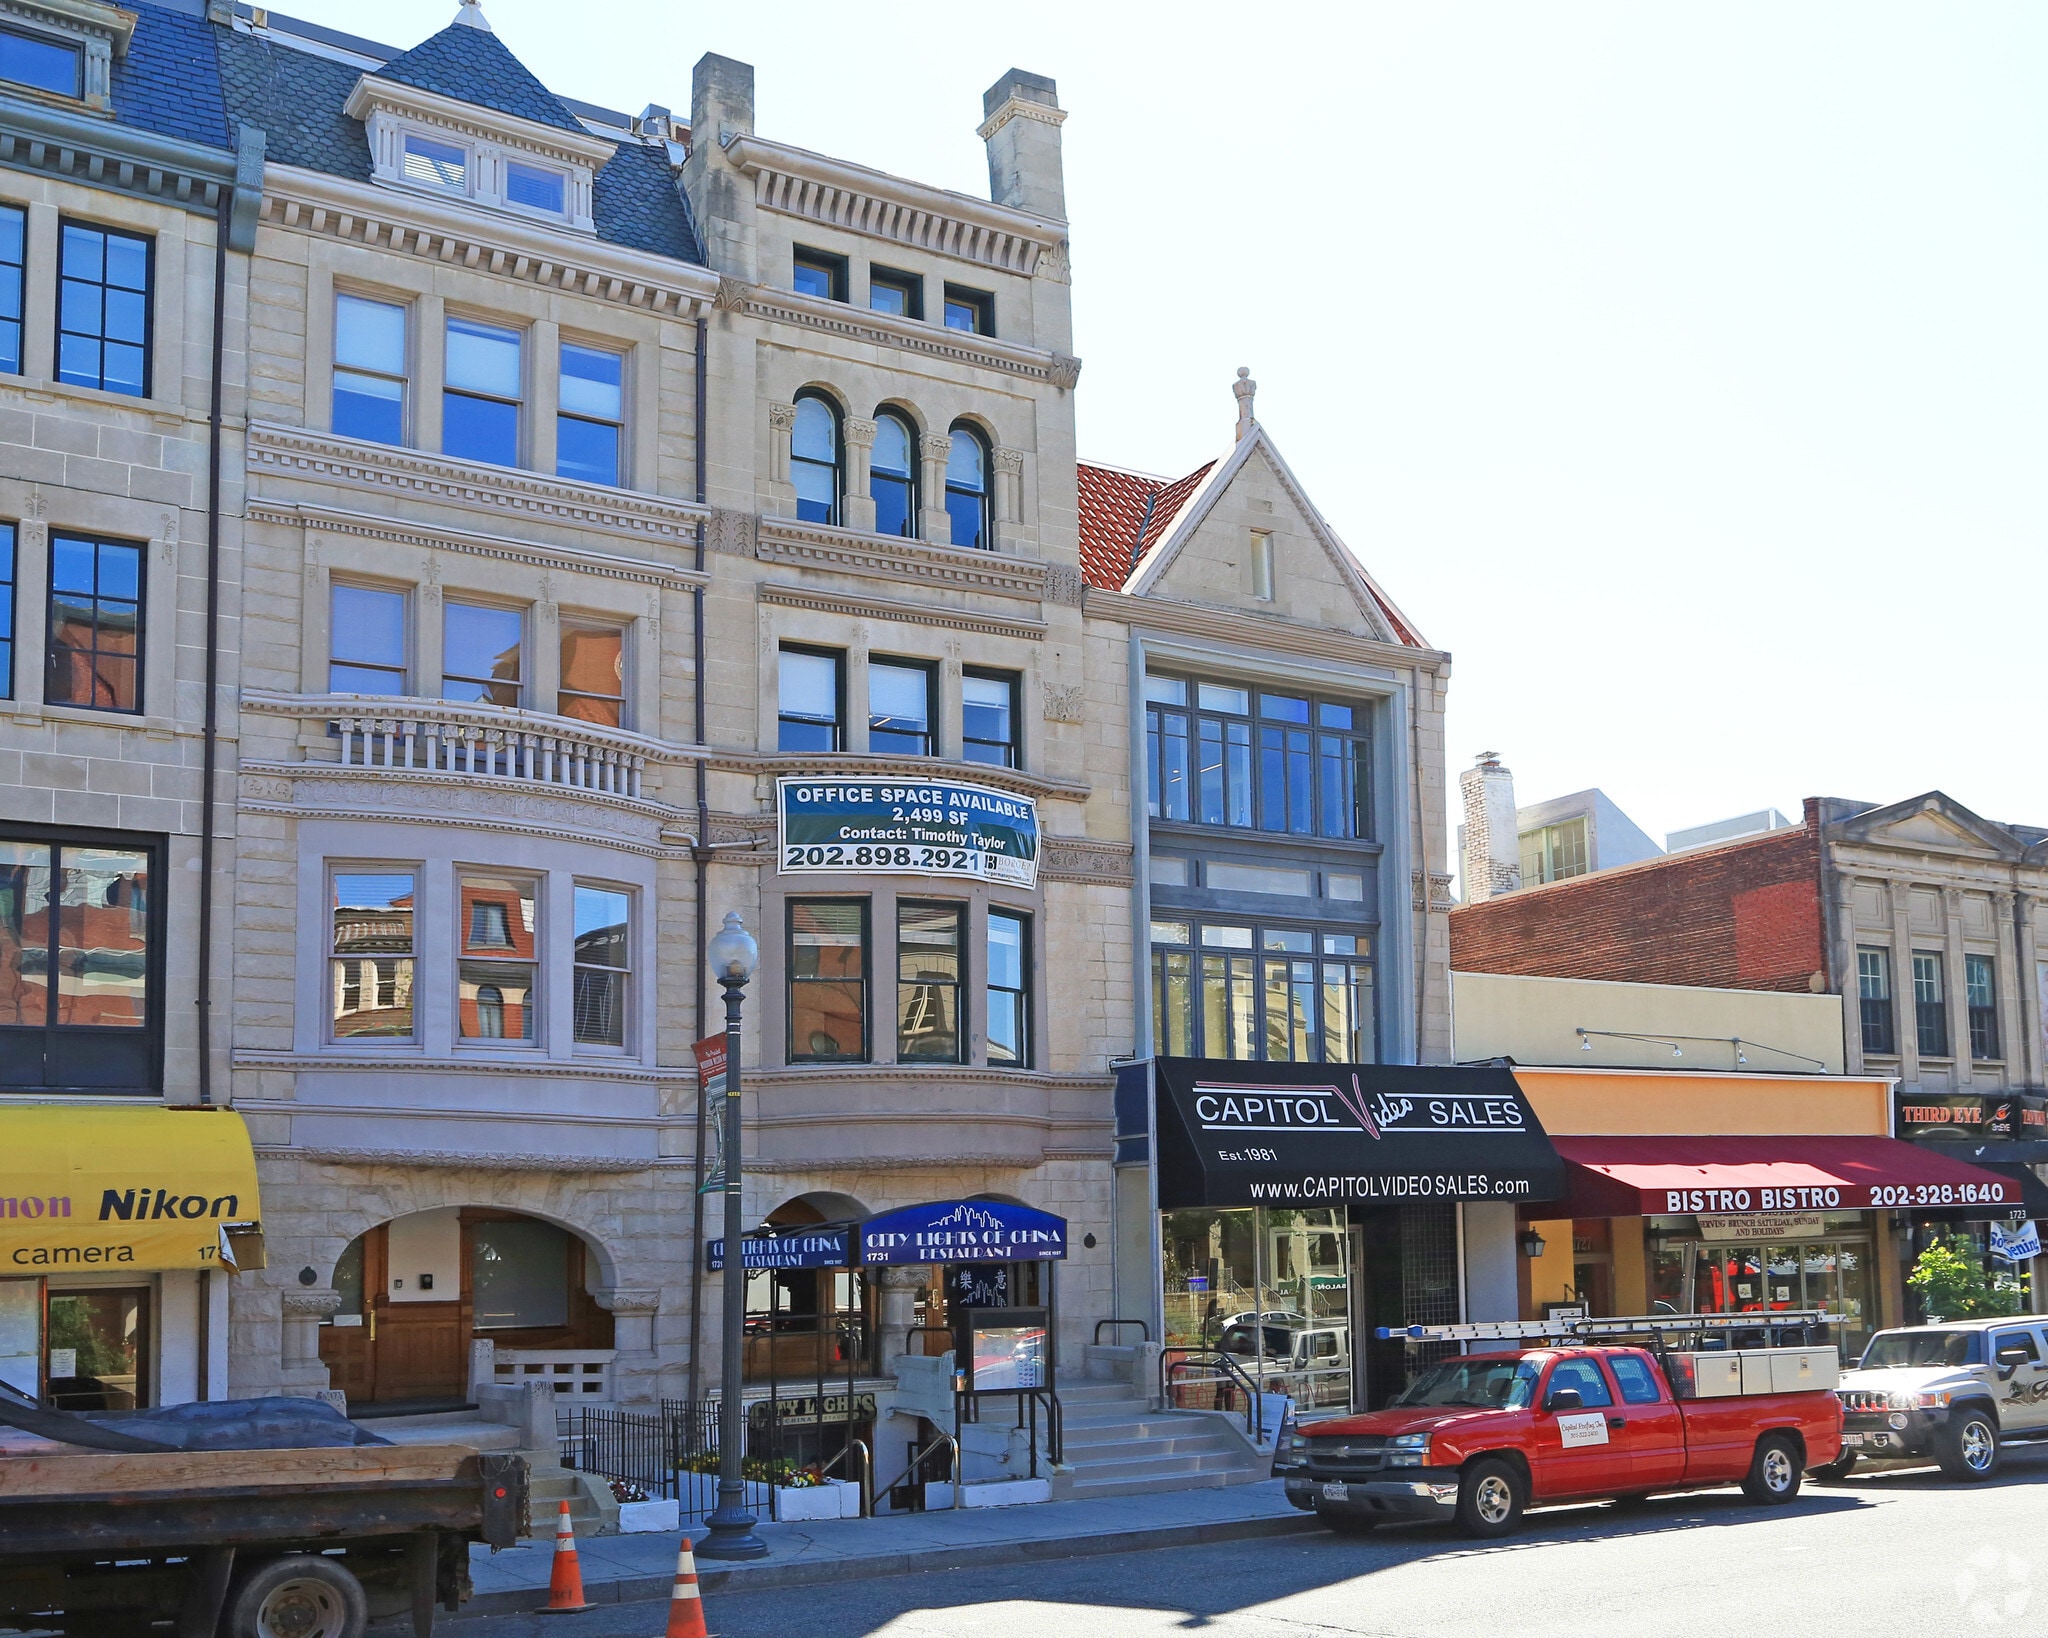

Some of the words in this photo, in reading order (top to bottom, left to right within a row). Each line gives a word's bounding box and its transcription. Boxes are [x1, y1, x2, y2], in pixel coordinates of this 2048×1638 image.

[796, 788, 873, 803] OFFICE
[880, 788, 943, 805] SPACE
[948, 791, 1029, 820] AVAILABLE
[892, 807, 943, 825] 2,499
[949, 812, 969, 826] SF
[839, 826, 907, 840] Contact:
[911, 828, 968, 847] Timothy
[971, 833, 1006, 850] Taylor
[787, 846, 979, 871] 202.898.2921
[1195, 1095, 1340, 1124] CAPITOL
[1334, 1073, 1414, 1140] Video
[1429, 1100, 1523, 1125] SALES
[1902, 1106, 1951, 1123] THIRD
[1952, 1107, 1982, 1124] EYE
[98, 1188, 239, 1221] Nikon
[1666, 1190, 1751, 1212] BISTRO
[1761, 1187, 1840, 1209] BISTRO
[1869, 1183, 2004, 1206] 202-328-1640
[1699, 1219, 1726, 1228] SERVING
[1728, 1219, 1757, 1228] BRUNCH
[1794, 1216, 1820, 1226] SUNDAY
[2009, 1210, 2027, 1219] 1723
[866, 1232, 911, 1248] CITY
[916, 1231, 977, 1247] LIGHTS
[982, 1230, 1005, 1245] OF
[1010, 1229, 1062, 1244] CHINA
[1735, 1228, 1750, 1236] AND
[1752, 1227, 1785, 1236] HOLIDAYS
[12, 1245, 135, 1265] camera
[742, 1239, 780, 1255] LIGHTS
[783, 1237, 800, 1253] OF
[803, 1237, 841, 1253] CHINA
[919, 1246, 1014, 1260] RESTAURANT
[744, 1254, 804, 1268] RESTAURANT
[866, 1252, 889, 1262] 1731
